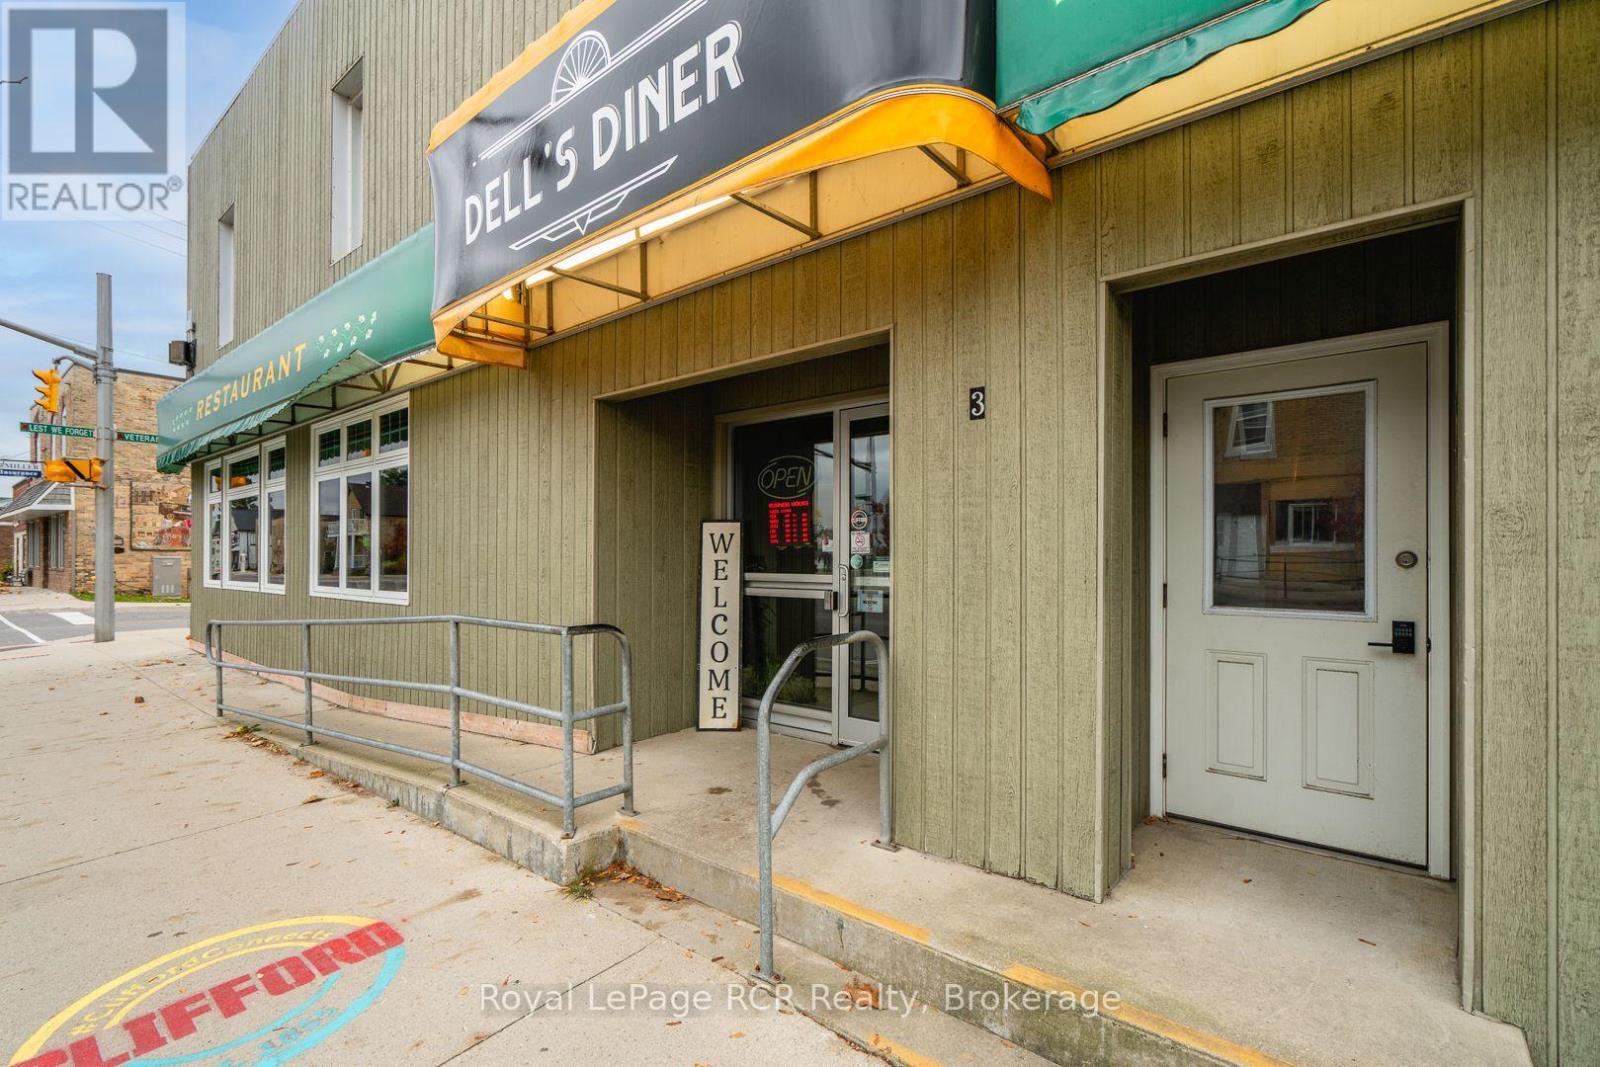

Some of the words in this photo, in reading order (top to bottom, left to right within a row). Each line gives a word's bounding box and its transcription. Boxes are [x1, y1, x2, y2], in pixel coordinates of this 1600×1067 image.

[465, 125, 578, 246] DELL'S
[592, 20, 744, 171] DINER
[195, 343, 306, 420] RESTAURANT
[971, 391, 985, 416] 3
[29, 424, 48, 433] LEST
[51, 427, 63, 435] WE
[65, 427, 93, 437] FORGET
[760, 467, 812, 489] OPEN
[707, 533, 734, 719] WELCOME
